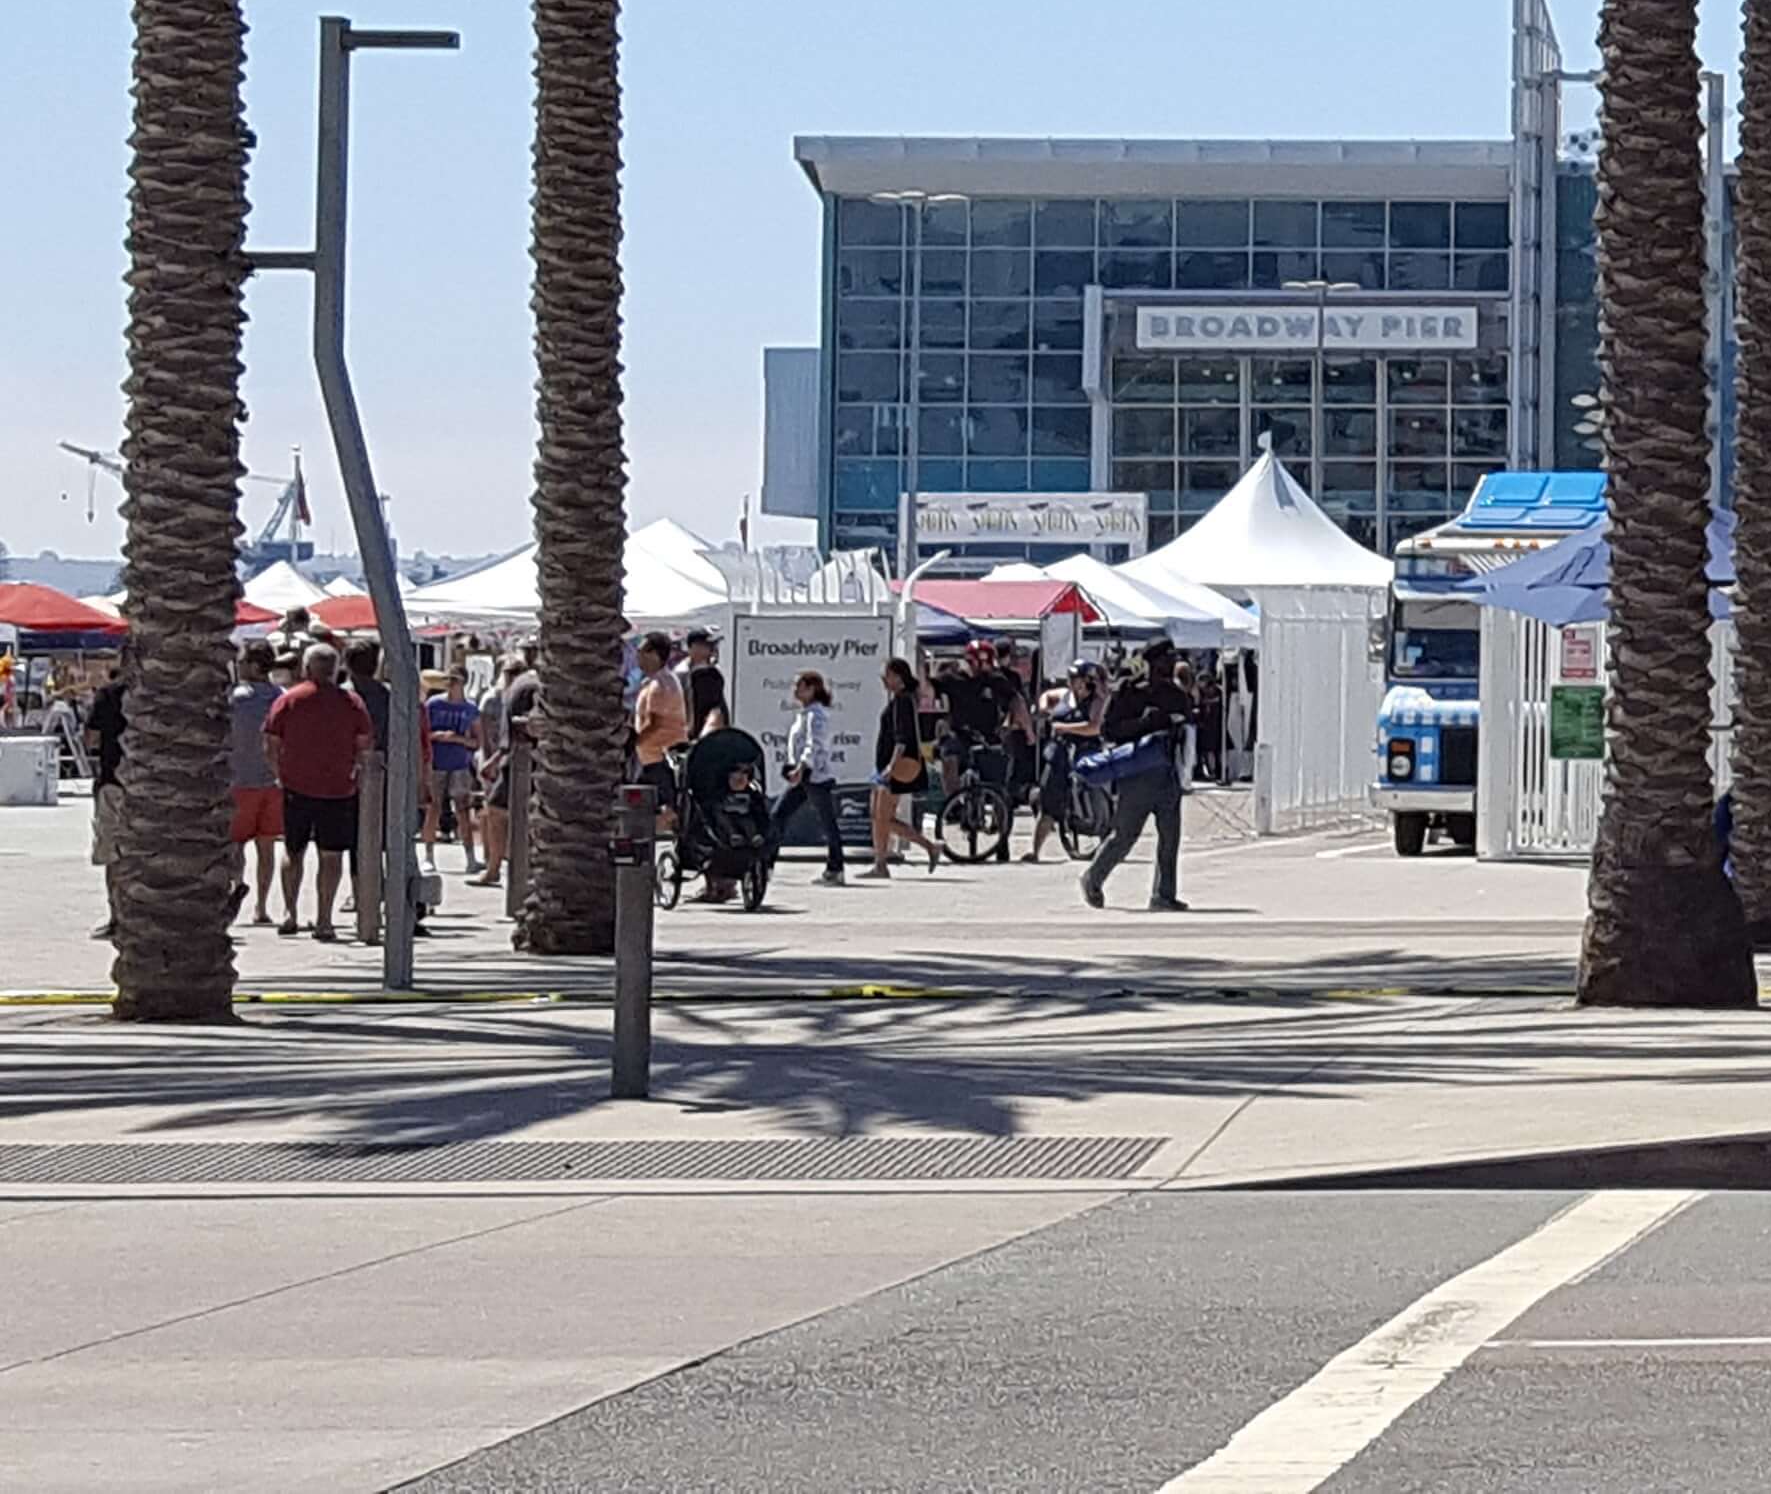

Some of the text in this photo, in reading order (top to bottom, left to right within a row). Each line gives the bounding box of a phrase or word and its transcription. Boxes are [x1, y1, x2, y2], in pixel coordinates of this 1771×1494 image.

[1150, 315, 1465, 339] BROADWAY PIER
[748, 638, 879, 660] Broadway Pier
